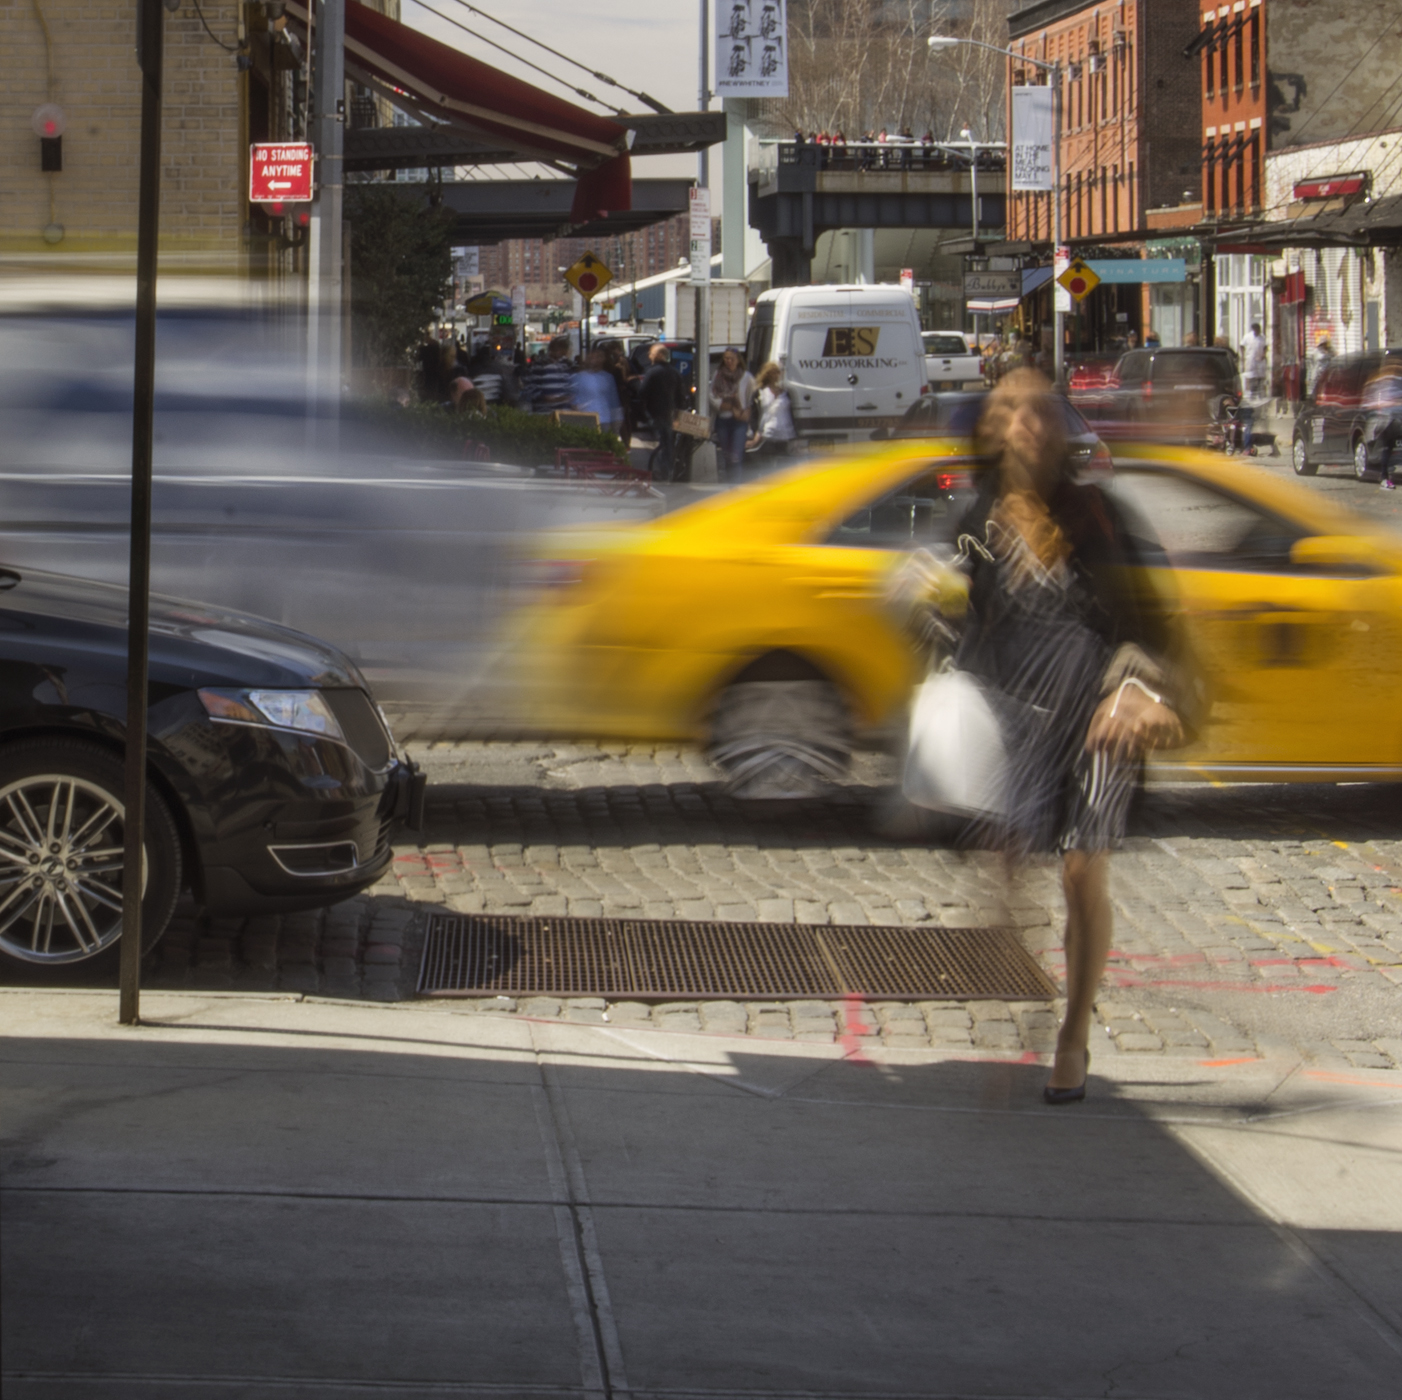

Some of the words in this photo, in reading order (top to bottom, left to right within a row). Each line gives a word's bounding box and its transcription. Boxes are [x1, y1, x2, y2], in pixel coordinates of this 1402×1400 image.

[1026, 144, 1050, 152] HOME
[256, 149, 268, 161] NO
[271, 148, 309, 161] STANDING
[261, 164, 303, 177] ANYTIME
[1015, 165, 1050, 173] PACKING
[797, 310, 846, 319] RESIDENTIAL
[857, 309, 906, 318] COMMERCIAL
[798, 358, 898, 370] WOODWORKING
